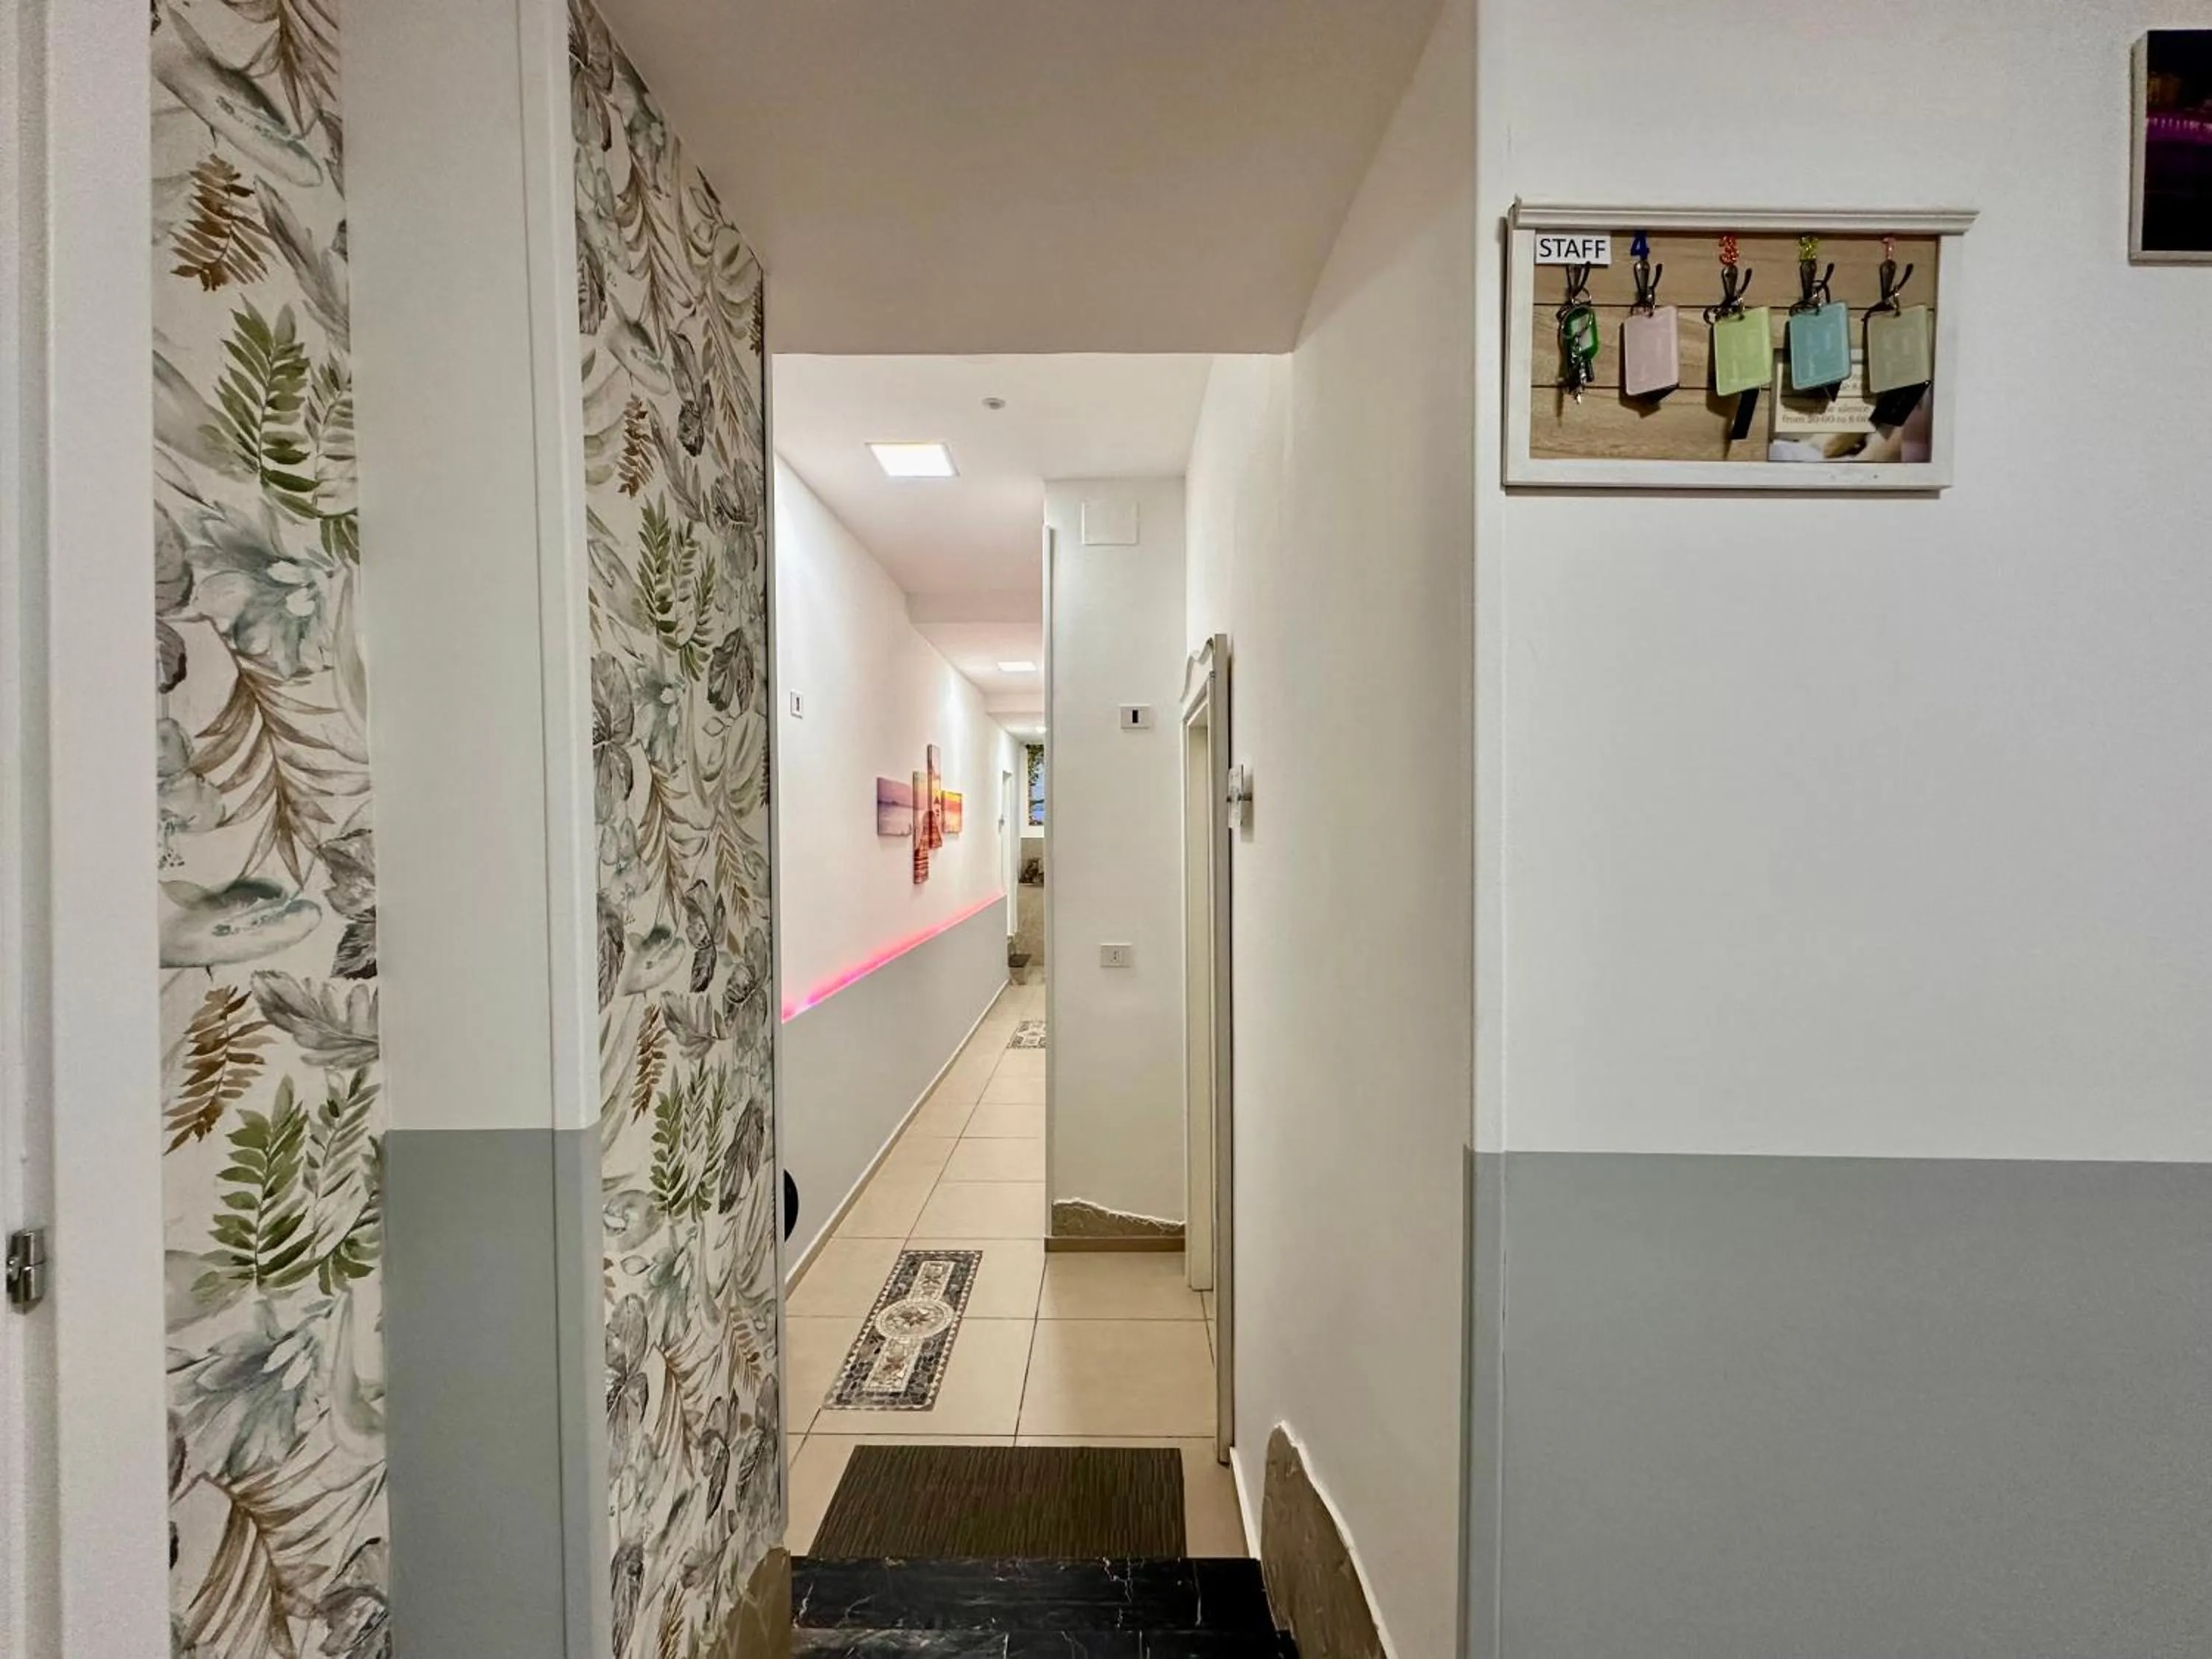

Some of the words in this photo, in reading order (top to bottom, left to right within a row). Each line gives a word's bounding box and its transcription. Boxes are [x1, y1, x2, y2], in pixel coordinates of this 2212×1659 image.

[1539, 237, 1606, 258] STAFF
[1630, 231, 1649, 260] 4
[1719, 232, 1739, 265] 3
